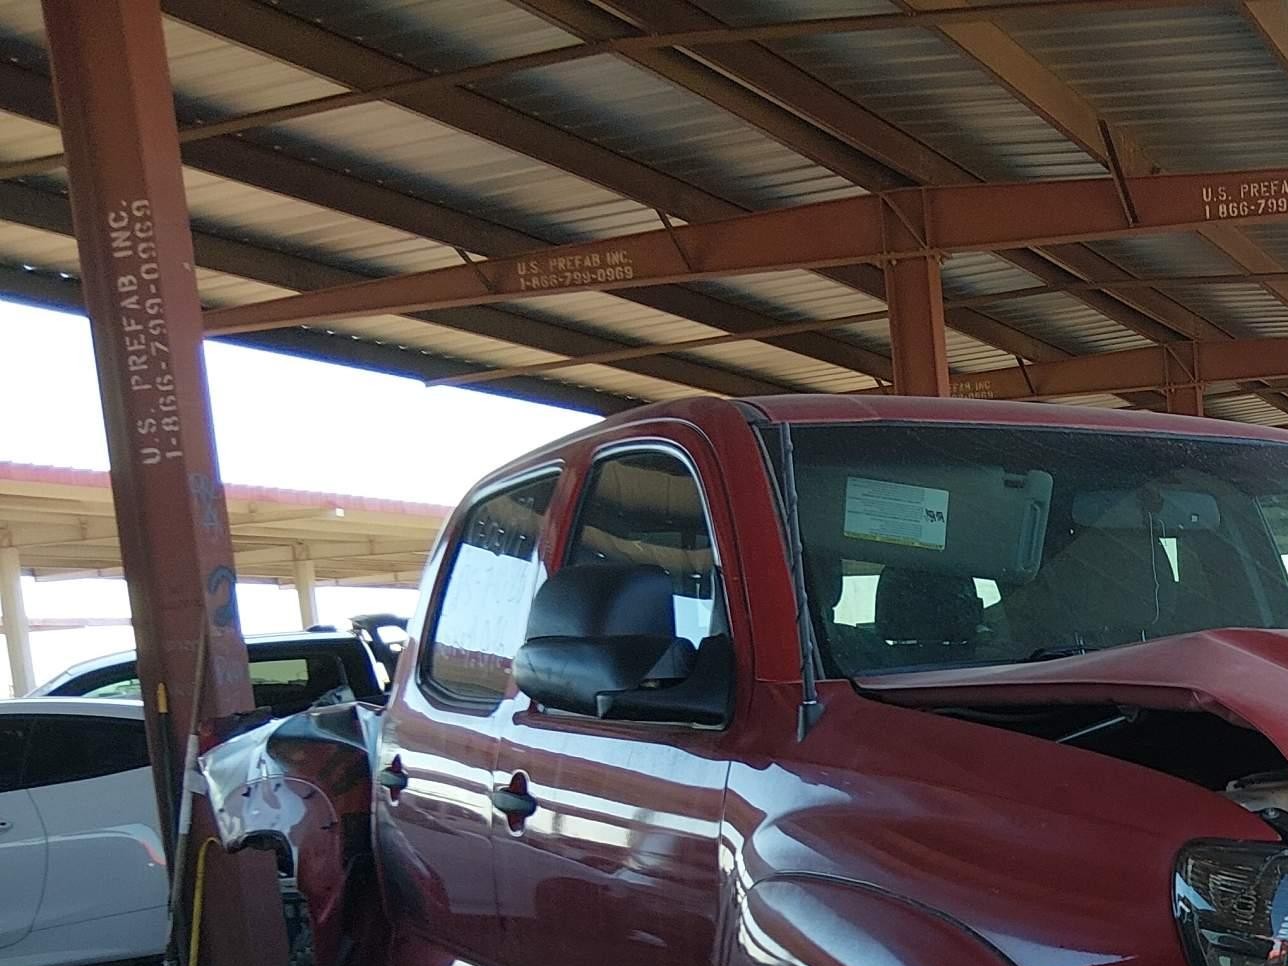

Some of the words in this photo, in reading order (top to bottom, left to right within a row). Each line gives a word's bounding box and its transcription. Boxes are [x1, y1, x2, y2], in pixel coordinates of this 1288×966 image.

[1202, 185, 1232, 202] U.S.
[109, 200, 132, 257] INC.
[519, 266, 633, 290] 1-866-799-0969
[551, 253, 600, 271] PREFAB
[607, 250, 633, 265] INC.
[117, 274, 151, 391] PREFAB
[131, 199, 183, 459] 1-866-799-0969
[137, 408, 161, 464] U.S.
